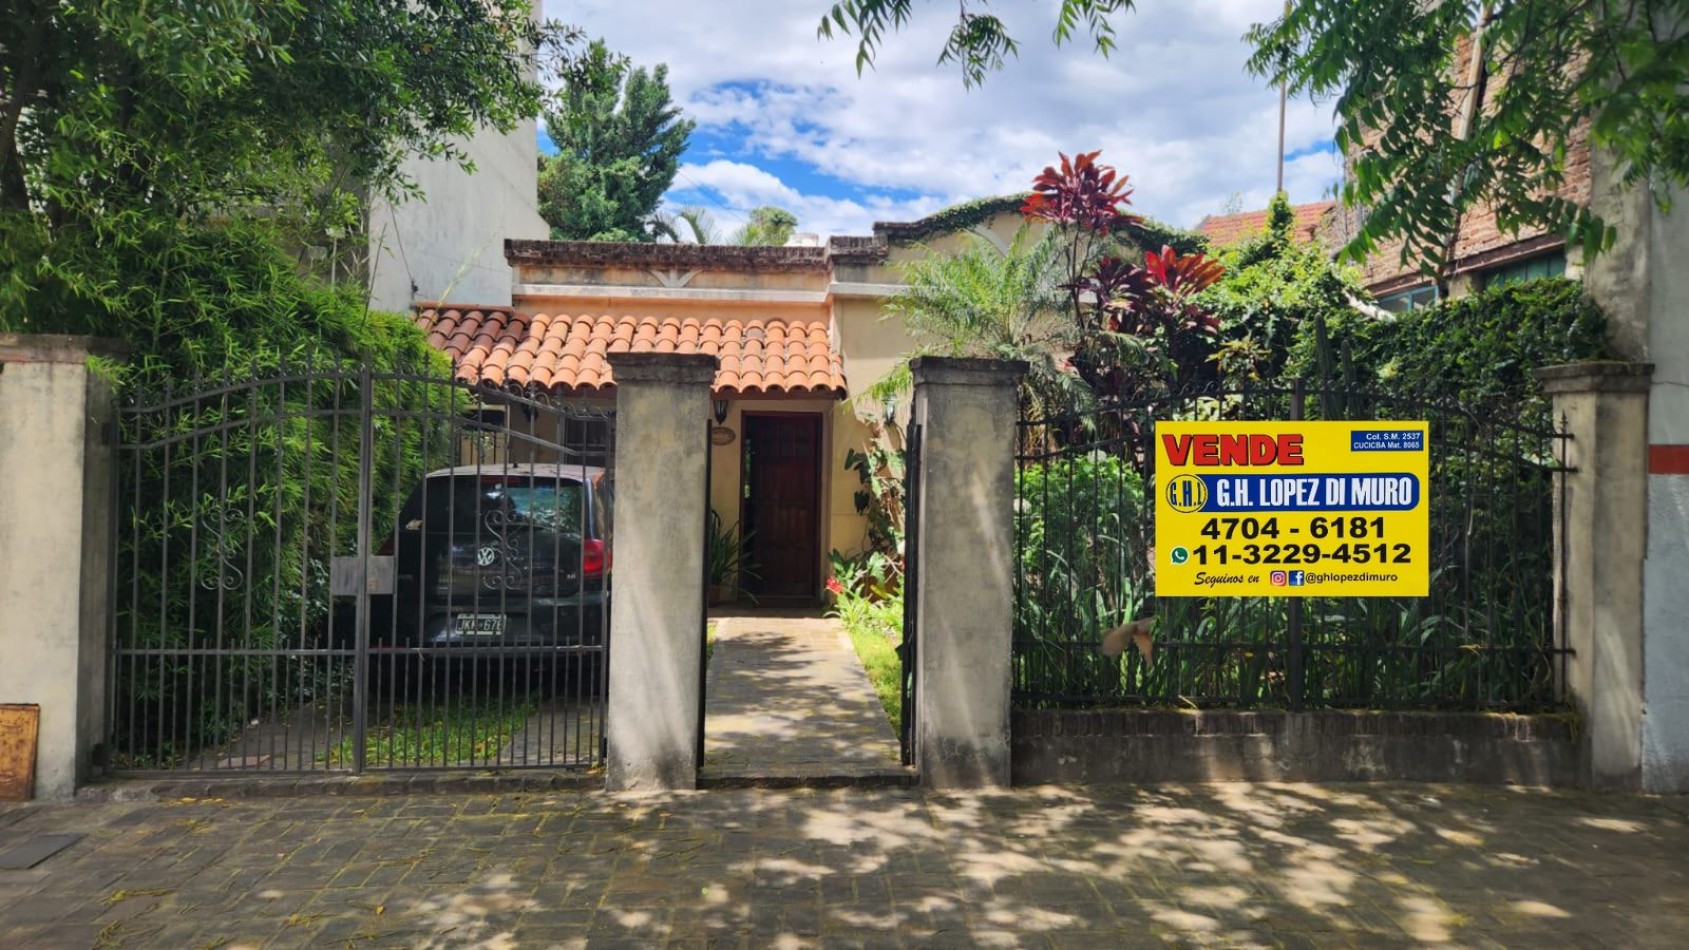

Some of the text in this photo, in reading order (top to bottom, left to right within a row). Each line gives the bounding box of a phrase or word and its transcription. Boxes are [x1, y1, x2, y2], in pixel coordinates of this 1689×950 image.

[1353, 441, 1386, 449] CUCICBA
[1366, 432, 1420, 440] Col. S.M. 2537
[1162, 434, 1304, 466] VENDE
[1217, 477, 1412, 506] G.H. LOPEZ DI MURO
[1201, 517, 1279, 539] 4704
[1310, 517, 1384, 538] 6181
[1193, 544, 1411, 565] 11-3229-4512
[1194, 572, 1244, 588] Seguinos
[1247, 574, 1260, 583] en
[1306, 572, 1398, 584] @ghlopezdimuro
